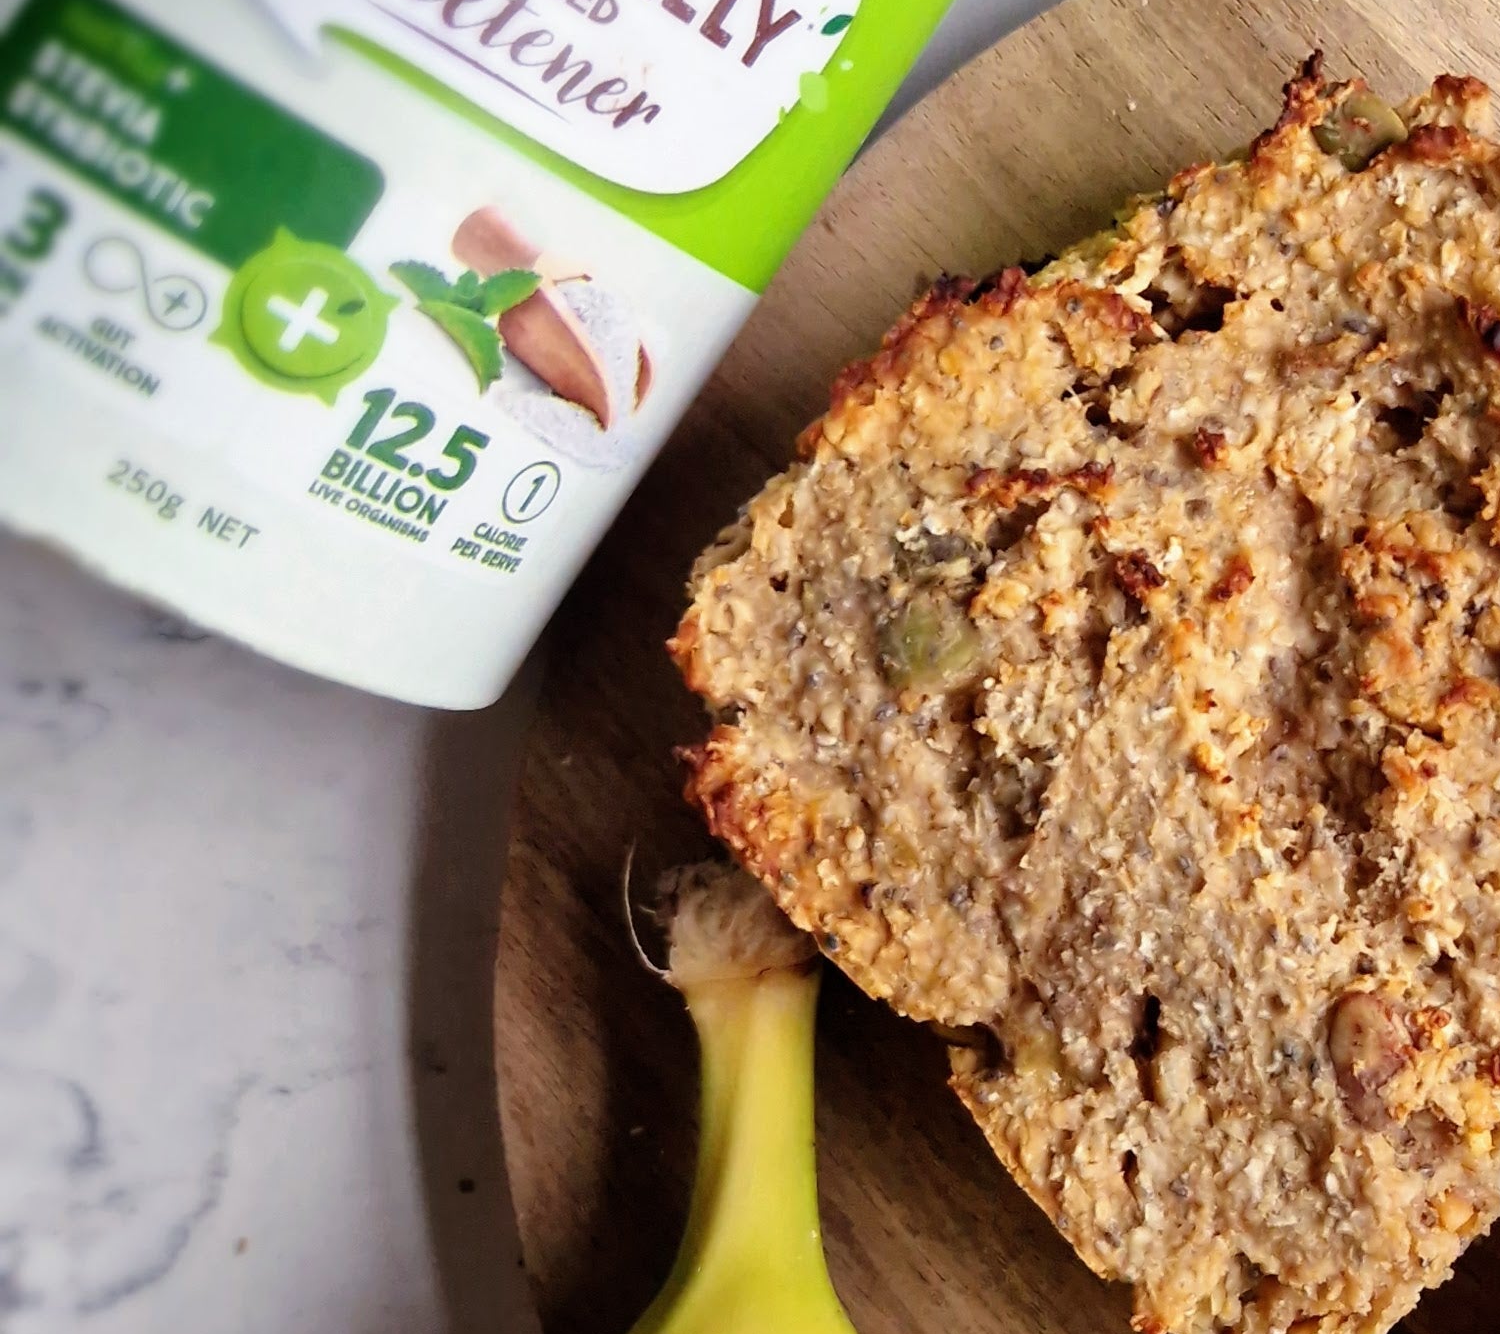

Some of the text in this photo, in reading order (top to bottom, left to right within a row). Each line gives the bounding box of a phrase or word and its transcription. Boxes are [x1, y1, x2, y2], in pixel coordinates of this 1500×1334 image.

[3, 185, 71, 261] 3
[37, 315, 161, 397] ACTIVATION
[90, 317, 137, 351] GUT
[345, 387, 491, 491] 12.5
[106, 458, 261, 550] 250g NET
[308, 479, 430, 543] LIVE ORGANISMS
[320, 449, 449, 525] BILLION
[518, 473, 547, 513] 1
[450, 536, 523, 573] PER SERVE
[473, 522, 528, 552] CALORIE
